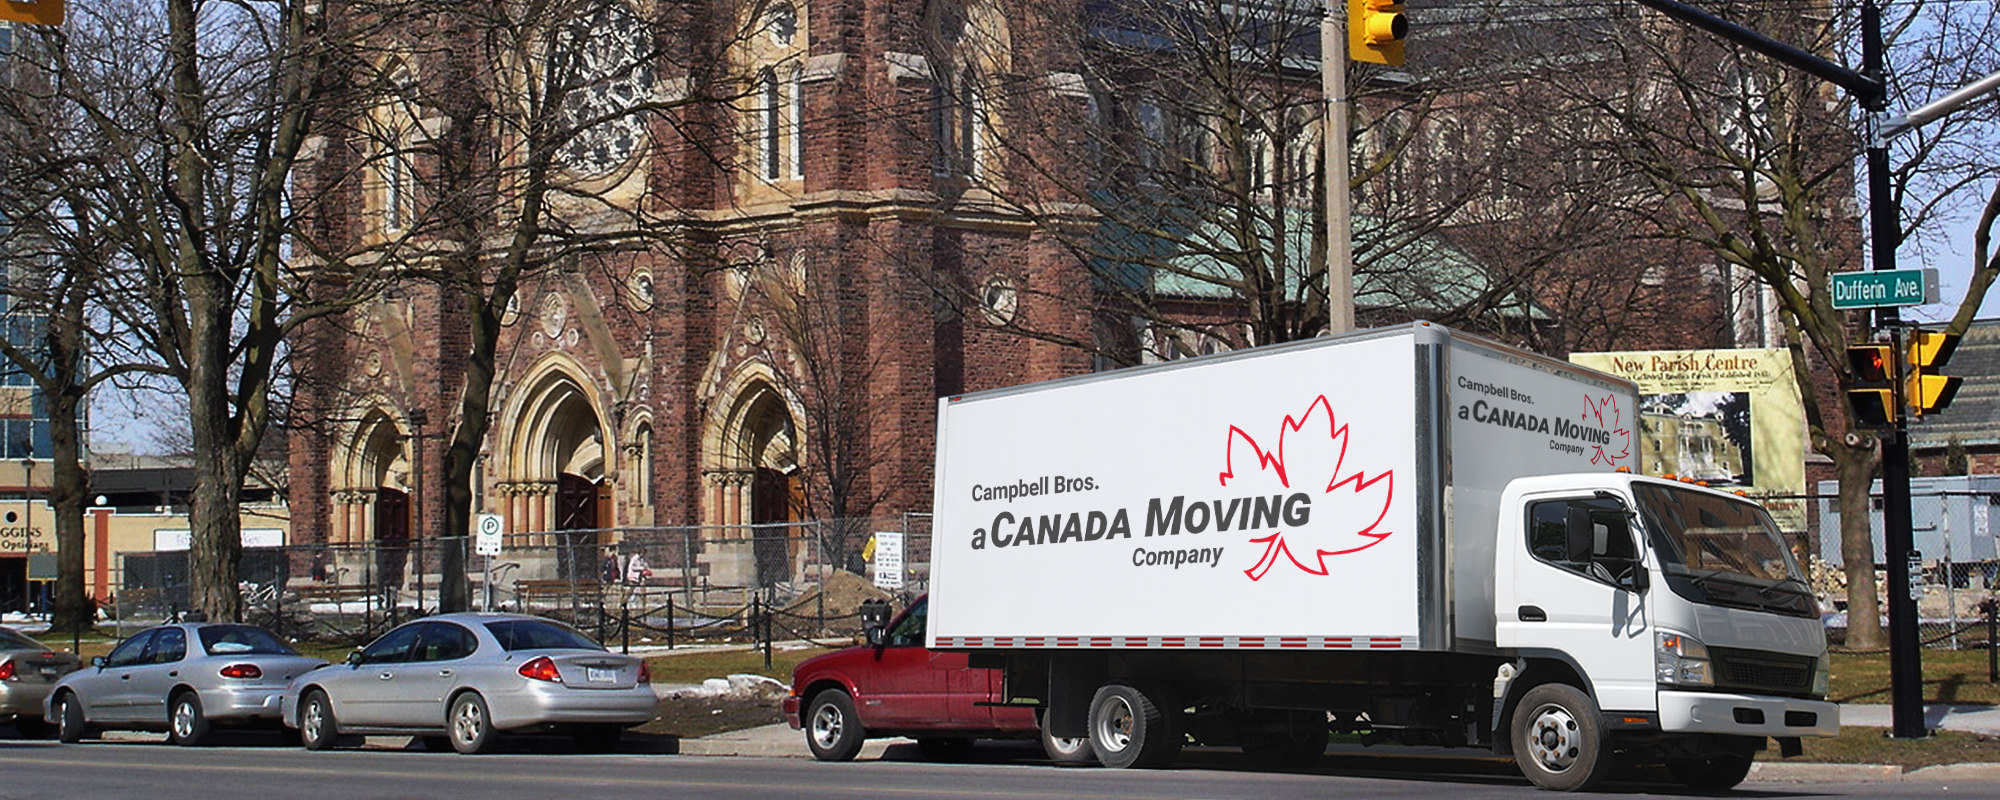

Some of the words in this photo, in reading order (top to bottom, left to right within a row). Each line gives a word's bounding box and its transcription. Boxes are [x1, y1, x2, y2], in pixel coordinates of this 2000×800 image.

[1836, 280, 1886, 300] Dufferin
[1894, 278, 1920, 298] Ave.
[1613, 356, 1645, 373] New
[1652, 354, 1699, 372] Parish
[1706, 353, 1758, 371] Centre
[1458, 376, 1509, 399] Campbell
[1510, 389, 1535, 405] Bros.
[1458, 405, 1469, 420] a
[1472, 400, 1550, 435] CANADA
[1553, 417, 1611, 445] MOVING
[1549, 440, 1585, 456] Company
[972, 476, 1049, 503] Campbell
[1053, 475, 1100, 494] Bros.
[971, 527, 987, 550] a
[990, 508, 1132, 548] CANADA
[1144, 492, 1312, 537] MOVING
[1132, 547, 1224, 569] Company
